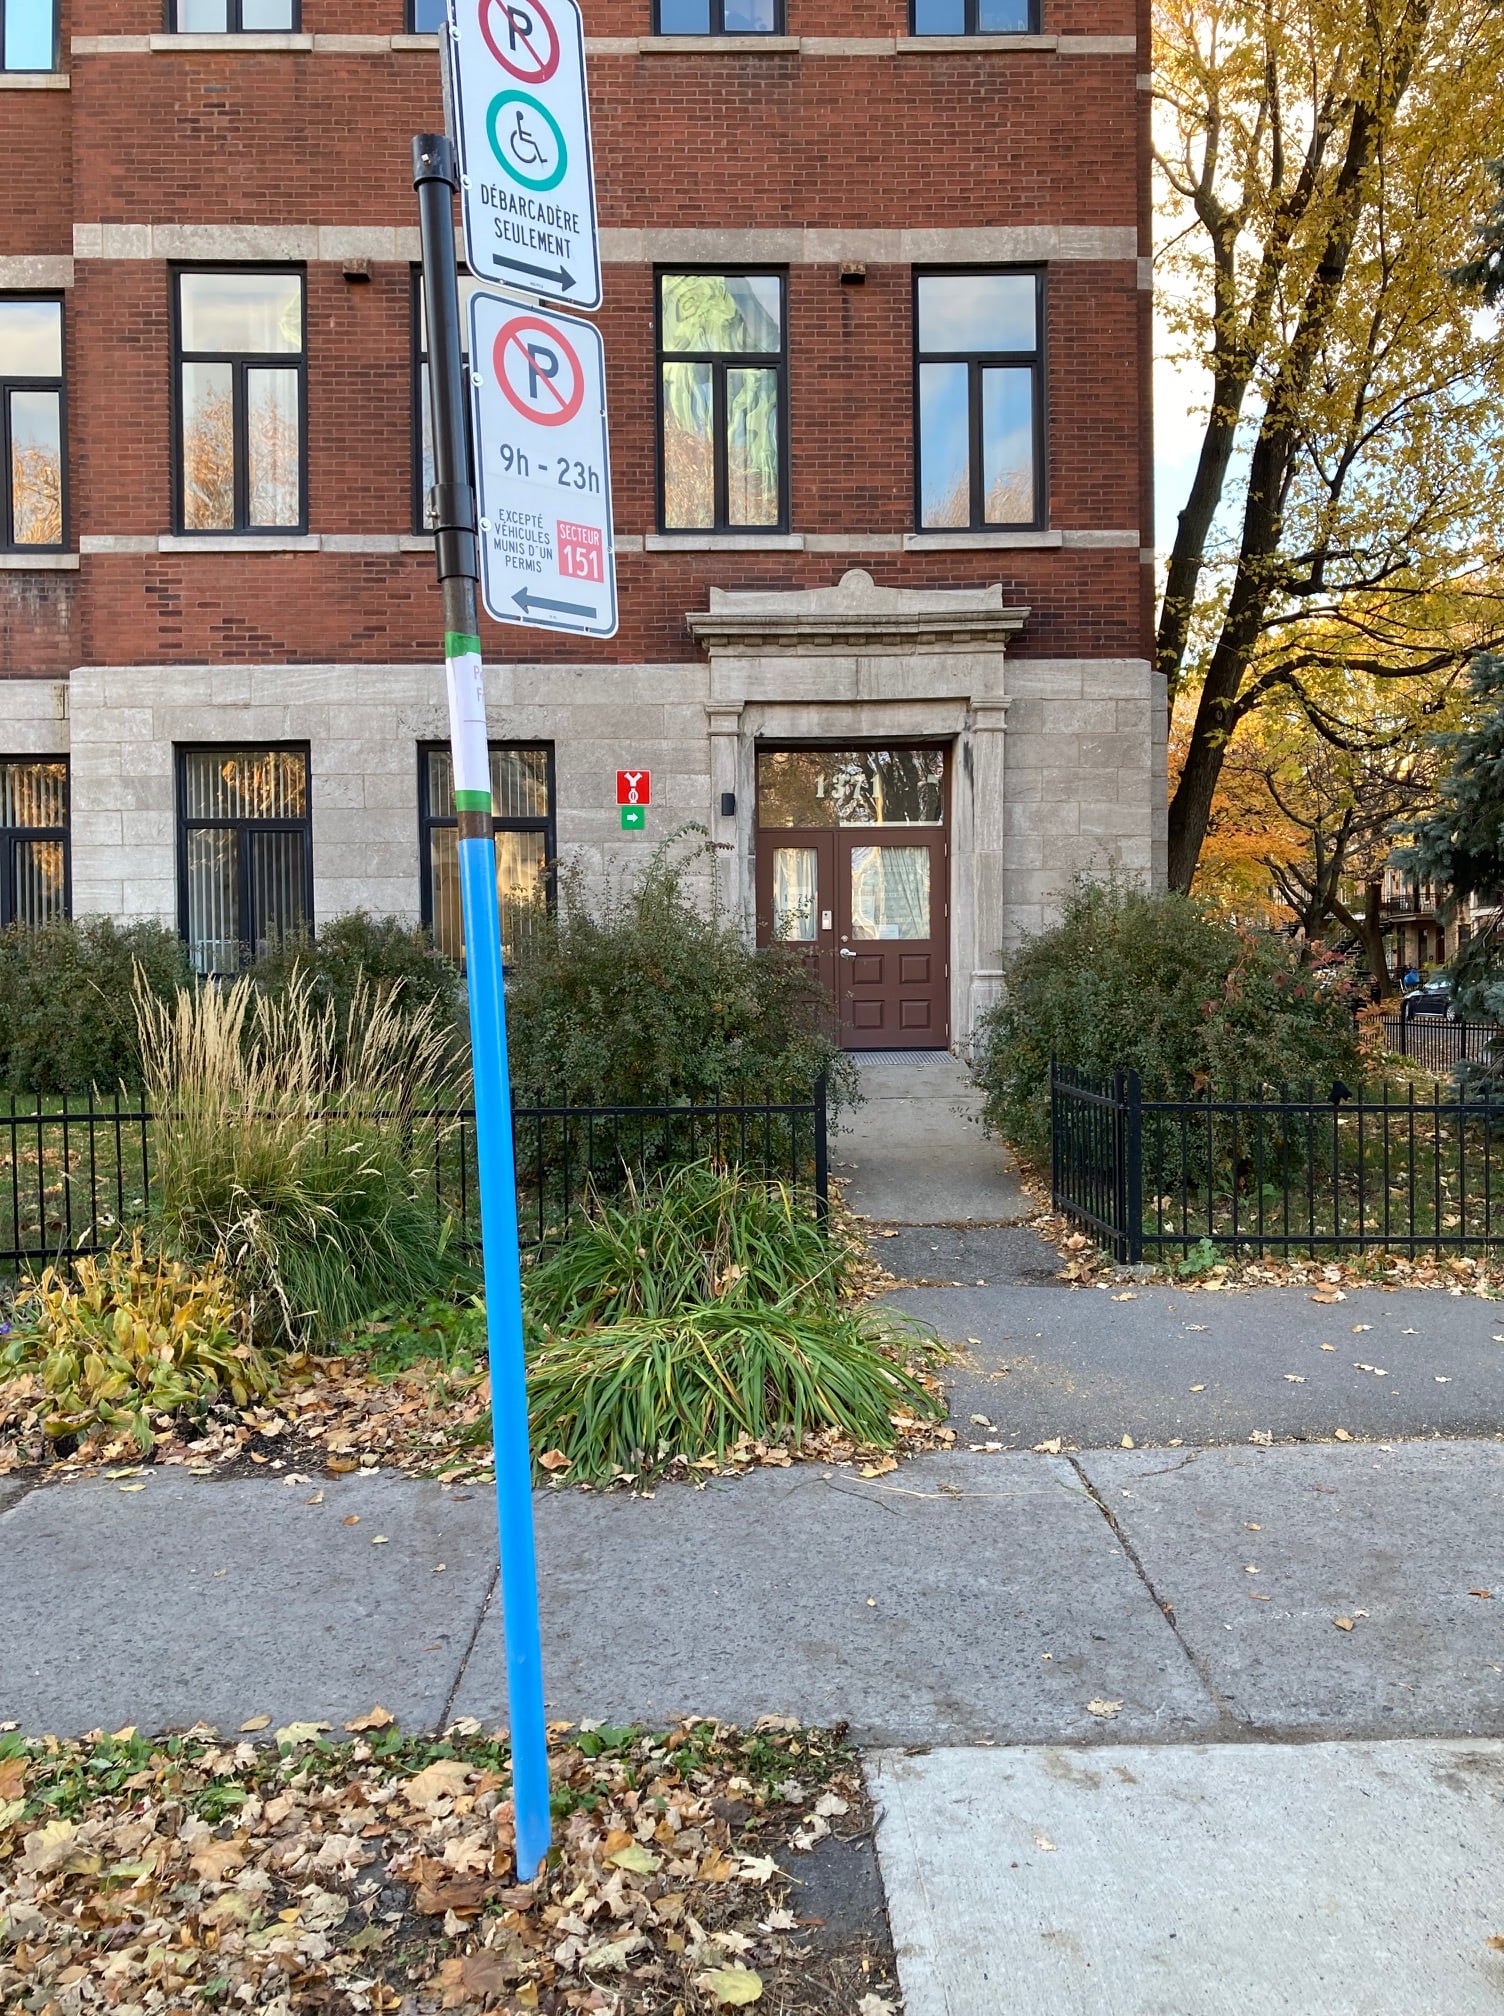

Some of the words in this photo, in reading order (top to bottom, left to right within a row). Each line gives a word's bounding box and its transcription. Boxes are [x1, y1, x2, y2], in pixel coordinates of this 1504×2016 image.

[481, 184, 580, 234] DÉBARCADÈRE
[494, 217, 570, 259] SEULEMENT
[500, 443, 529, 477] 9h
[557, 457, 600, 493] 23h
[498, 507, 544, 529] EXCEPTÉ
[494, 521, 551, 545] VÉHICULES
[559, 523, 600, 546] SECTEUR
[493, 537, 526, 557] MUNIS
[505, 554, 543, 574] PERMIS
[563, 545, 599, 579] 151
[815, 773, 881, 798] 1371
